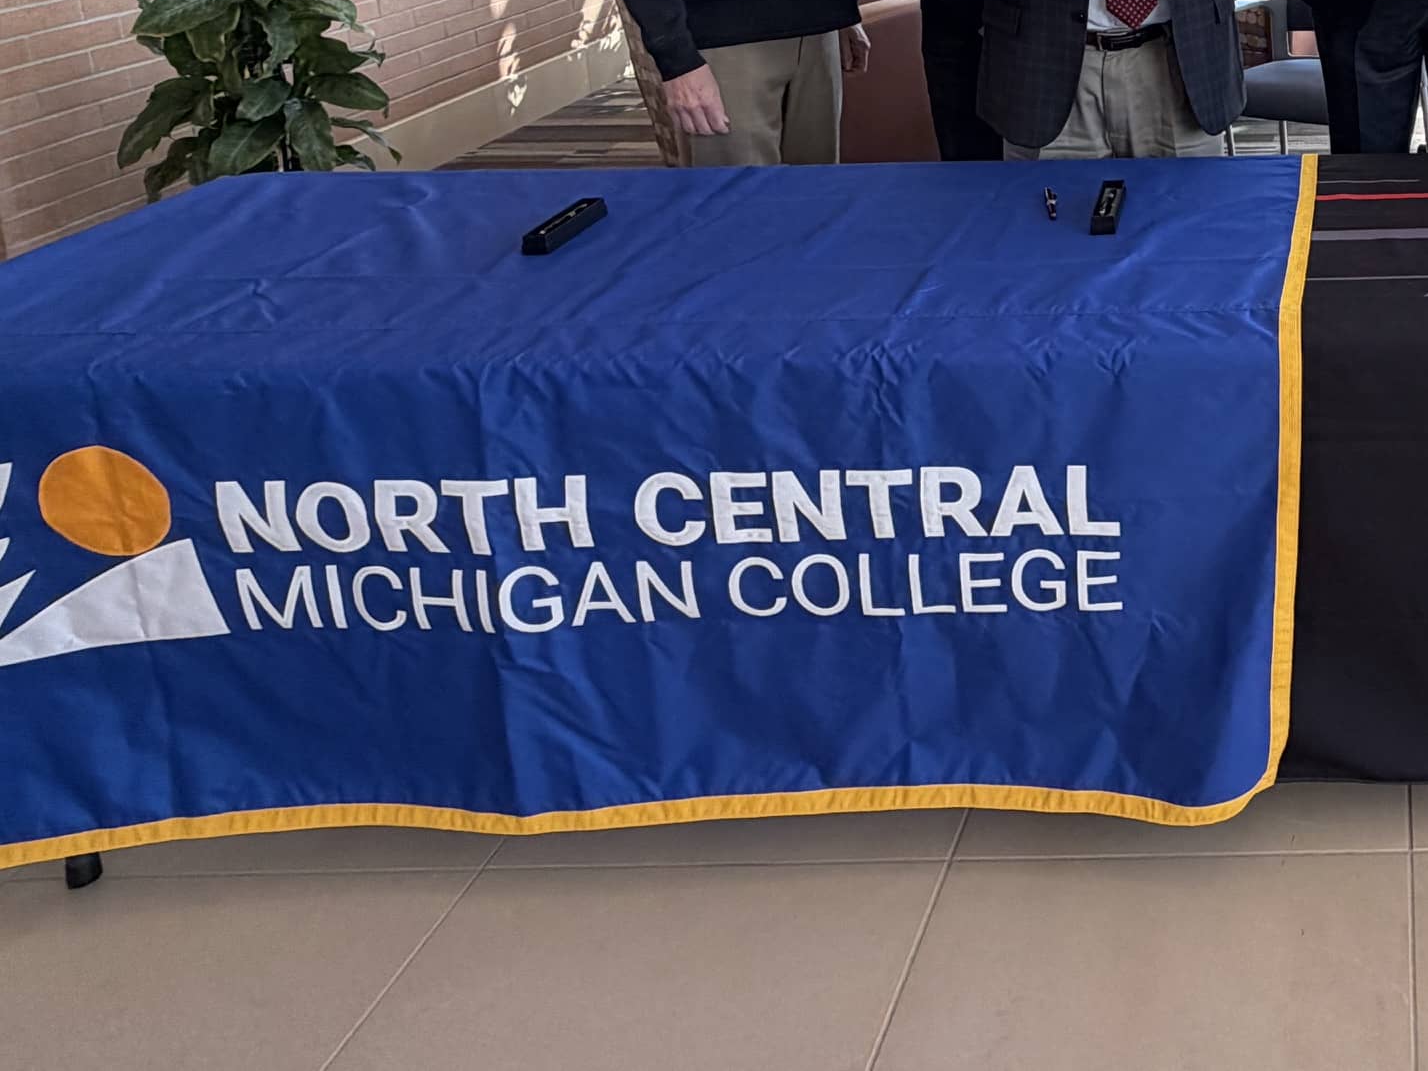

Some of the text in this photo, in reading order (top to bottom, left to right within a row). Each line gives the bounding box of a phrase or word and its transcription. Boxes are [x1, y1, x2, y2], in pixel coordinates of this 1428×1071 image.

[215, 465, 1121, 555] NORTH CENTRAL
[235, 549, 1123, 633] MICHIGAN COLLEGE
